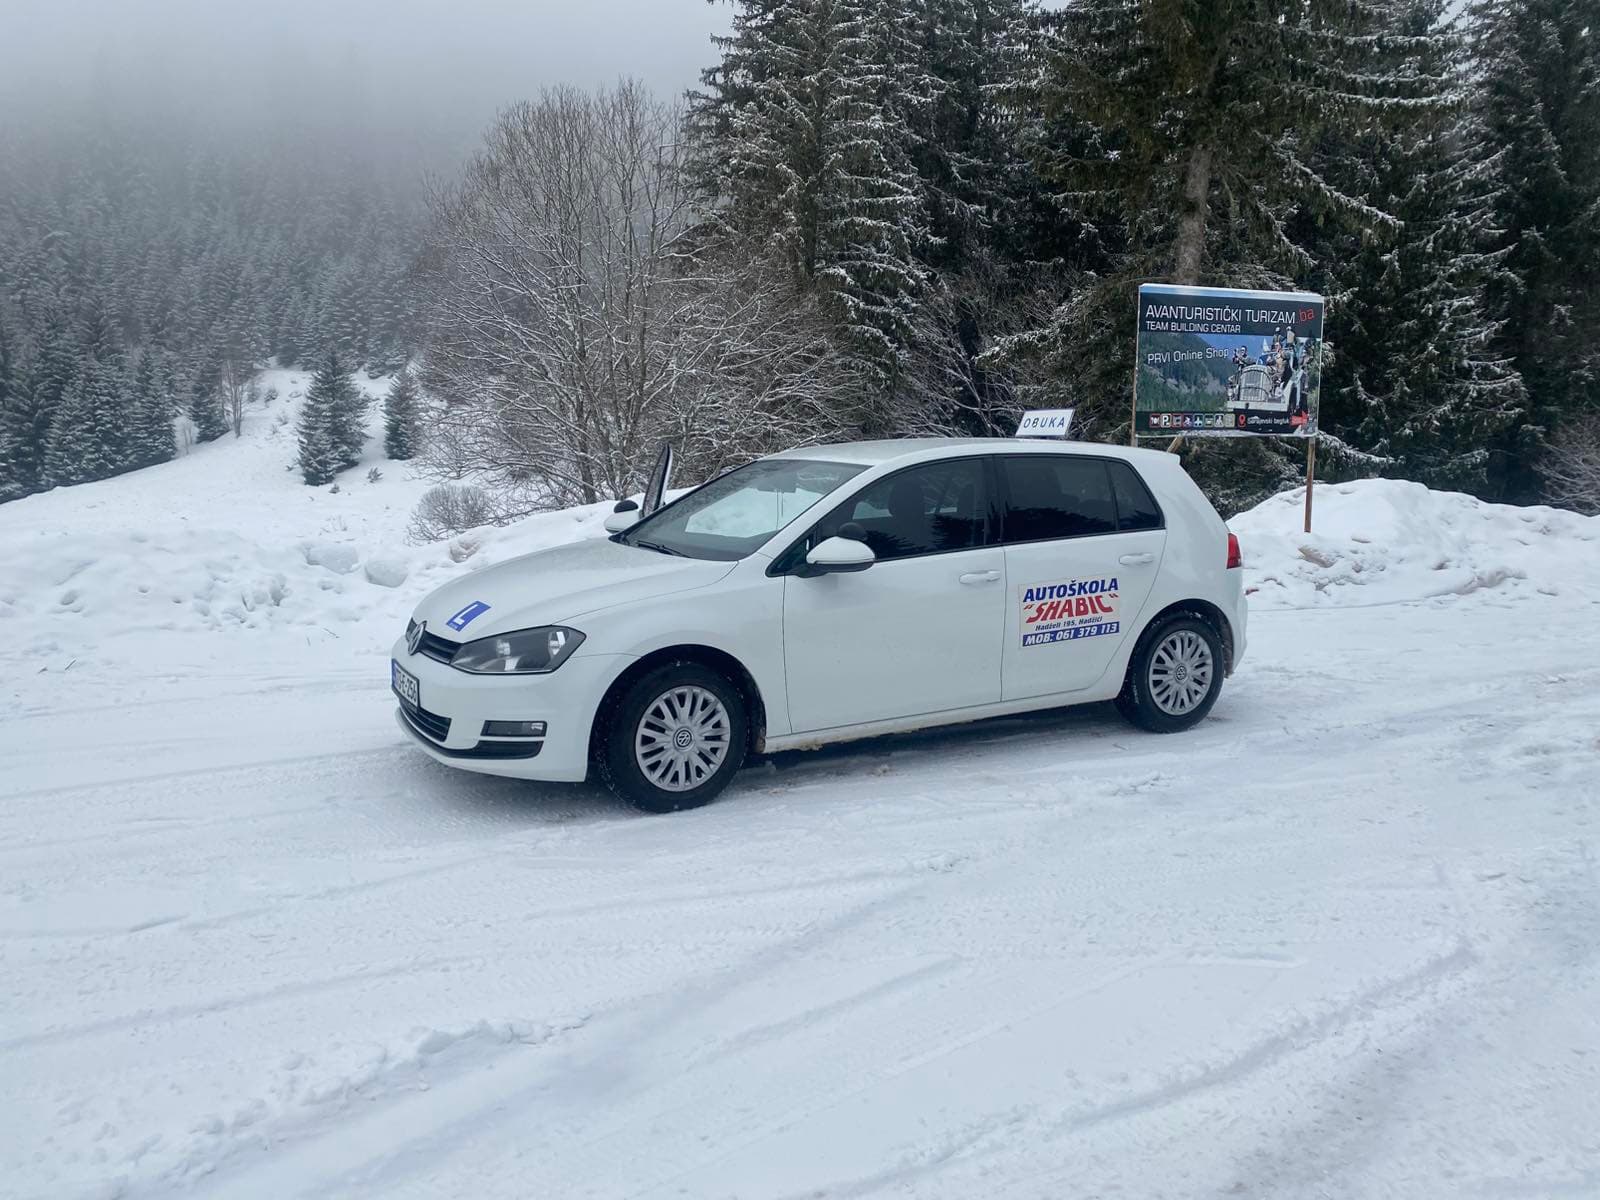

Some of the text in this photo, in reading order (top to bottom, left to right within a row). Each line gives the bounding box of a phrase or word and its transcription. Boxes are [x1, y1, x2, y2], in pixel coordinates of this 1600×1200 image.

[1145, 304, 1242, 322] AVANTURISTIČKI
[1245, 309, 1296, 324] TURIZAM
[1146, 320, 1242, 333] TEAM BUILDING CENTAR
[1147, 347, 1230, 364] PRVI Online Shop
[1023, 416, 1065, 429] OBUKA
[1162, 415, 1170, 426] P
[1023, 578, 1119, 603] AUTOŠKOLA
[1024, 623, 1118, 646] MOB: 061 379 113
